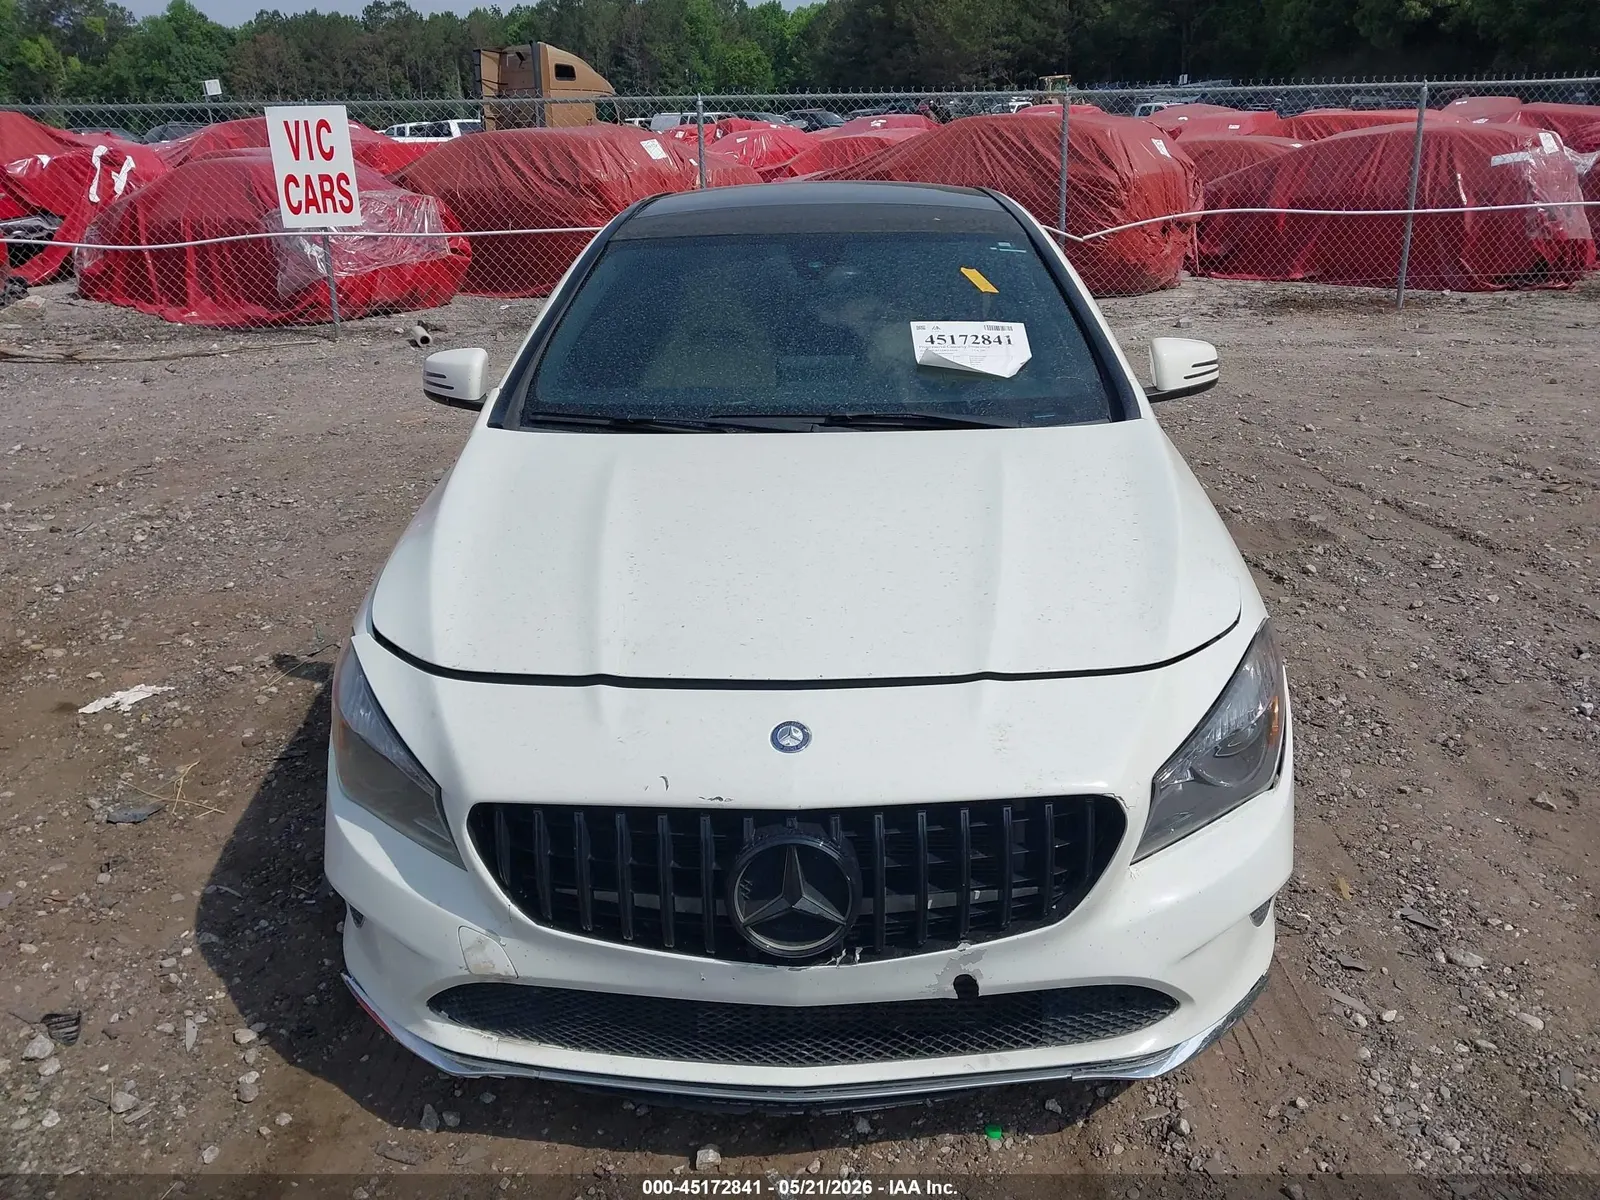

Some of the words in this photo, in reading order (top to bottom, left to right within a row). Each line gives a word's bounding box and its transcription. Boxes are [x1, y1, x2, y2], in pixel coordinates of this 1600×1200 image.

[283, 118, 335, 161] VIC
[284, 172, 354, 215] CARS
[925, 334, 1013, 346] 45172841
